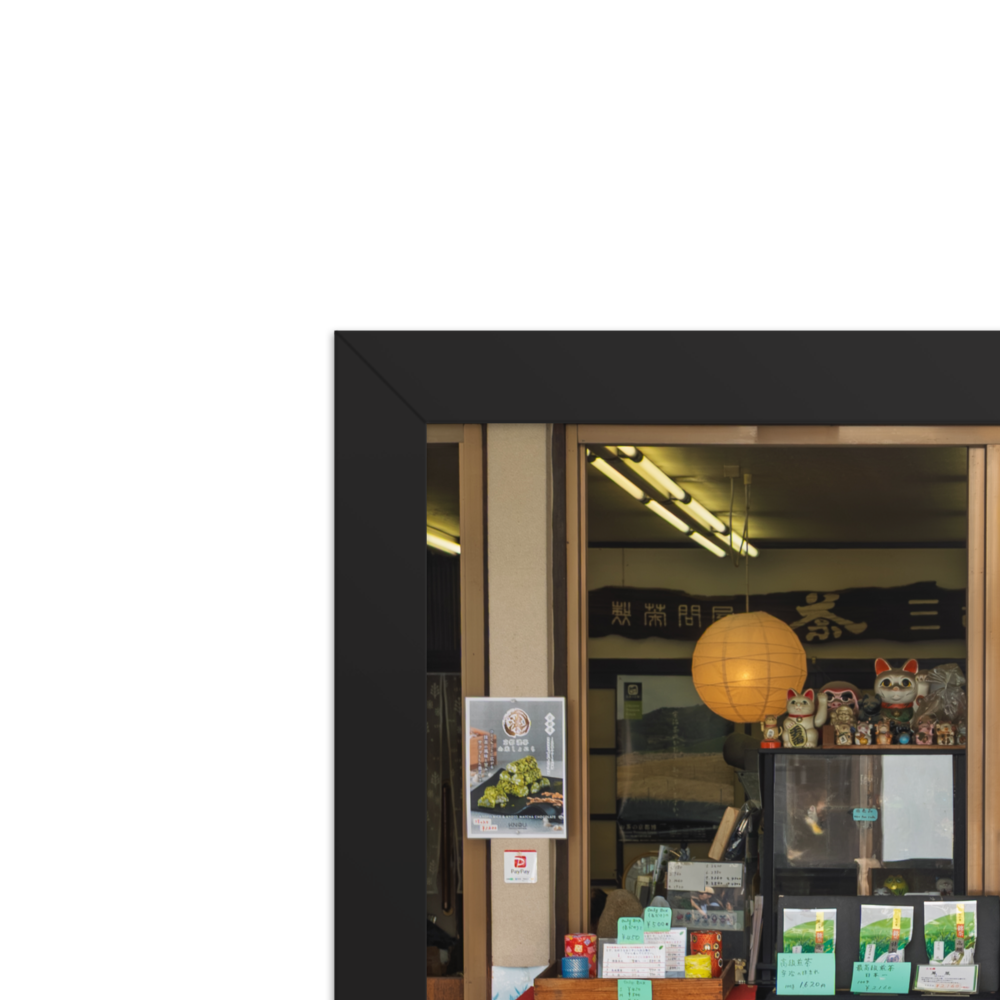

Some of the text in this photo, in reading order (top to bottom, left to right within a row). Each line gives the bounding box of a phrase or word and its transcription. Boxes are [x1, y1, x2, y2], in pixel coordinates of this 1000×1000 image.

[780, 957, 812, 967] 高級煎茶
[856, 964, 895, 972] 最高級煎茶
